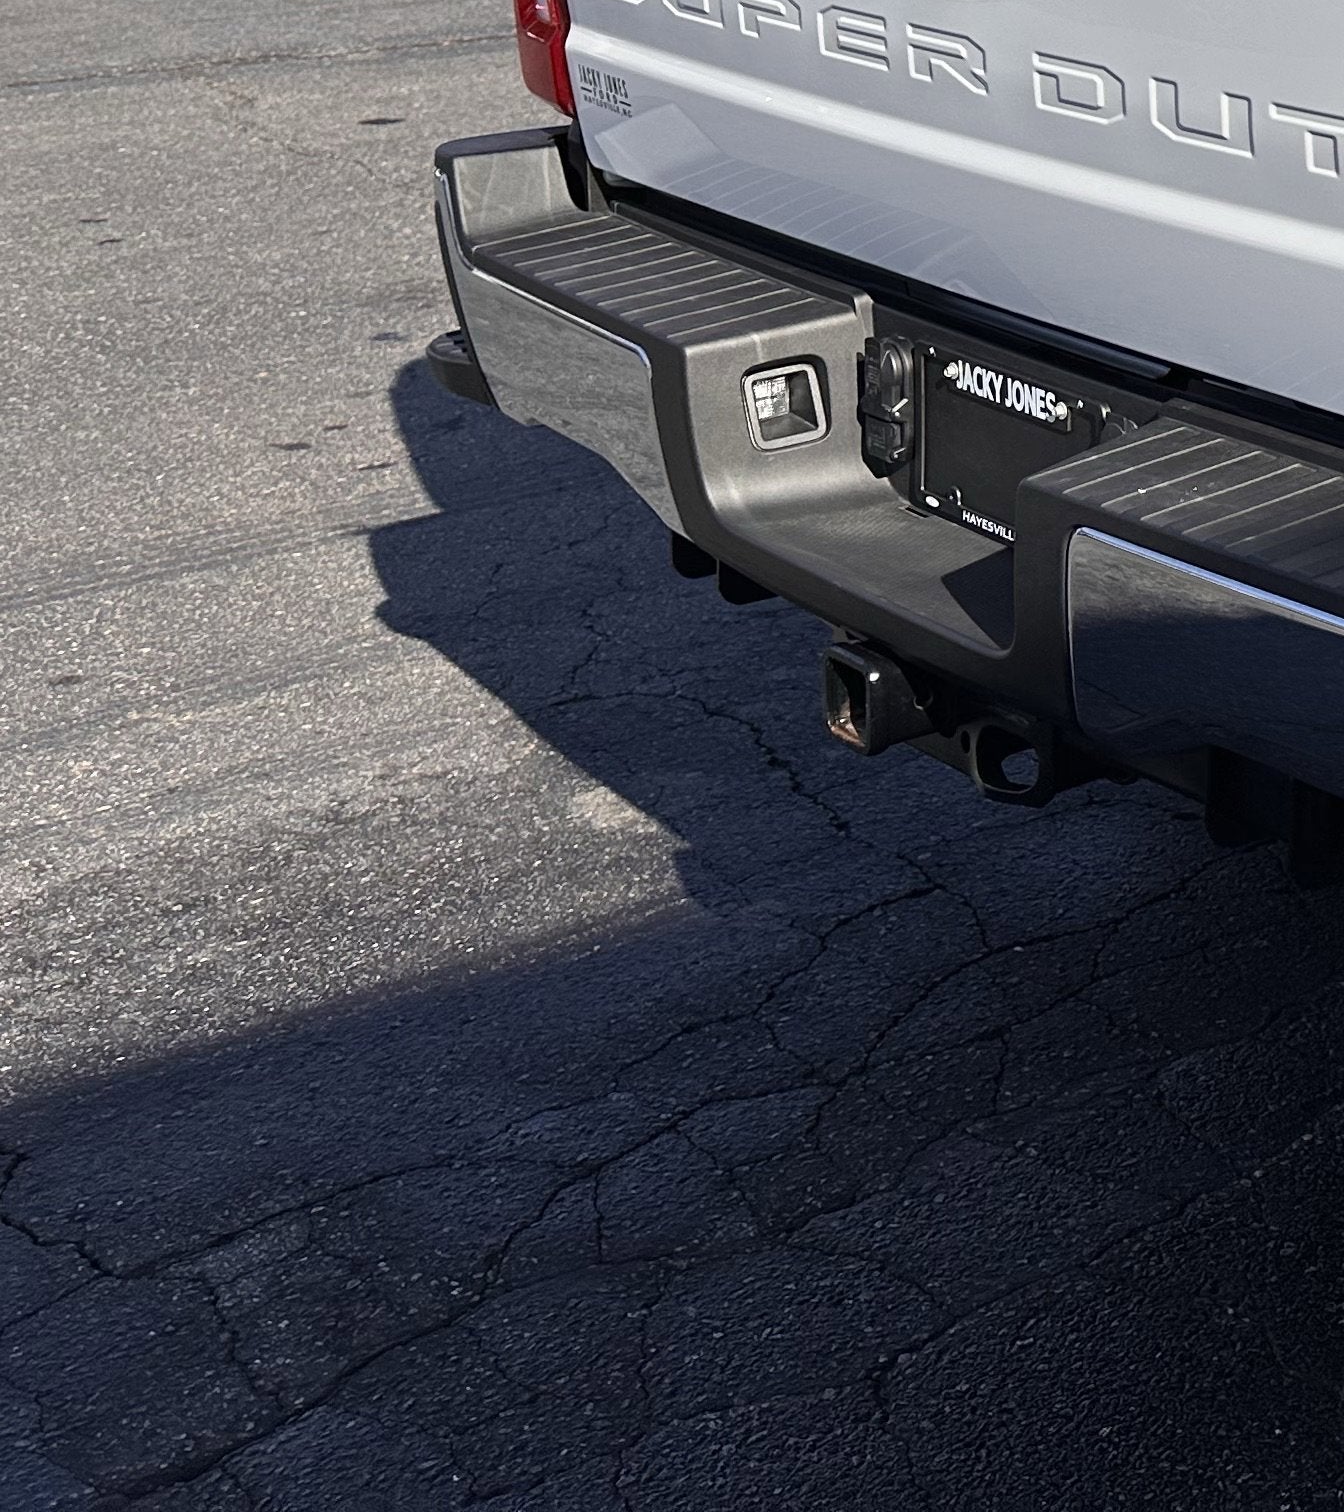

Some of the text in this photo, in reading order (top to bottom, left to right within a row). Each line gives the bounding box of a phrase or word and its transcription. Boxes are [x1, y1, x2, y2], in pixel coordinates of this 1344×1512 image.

[956, 359, 1057, 421] JACKY JONES
[962, 509, 1016, 542] HAYESVILL
